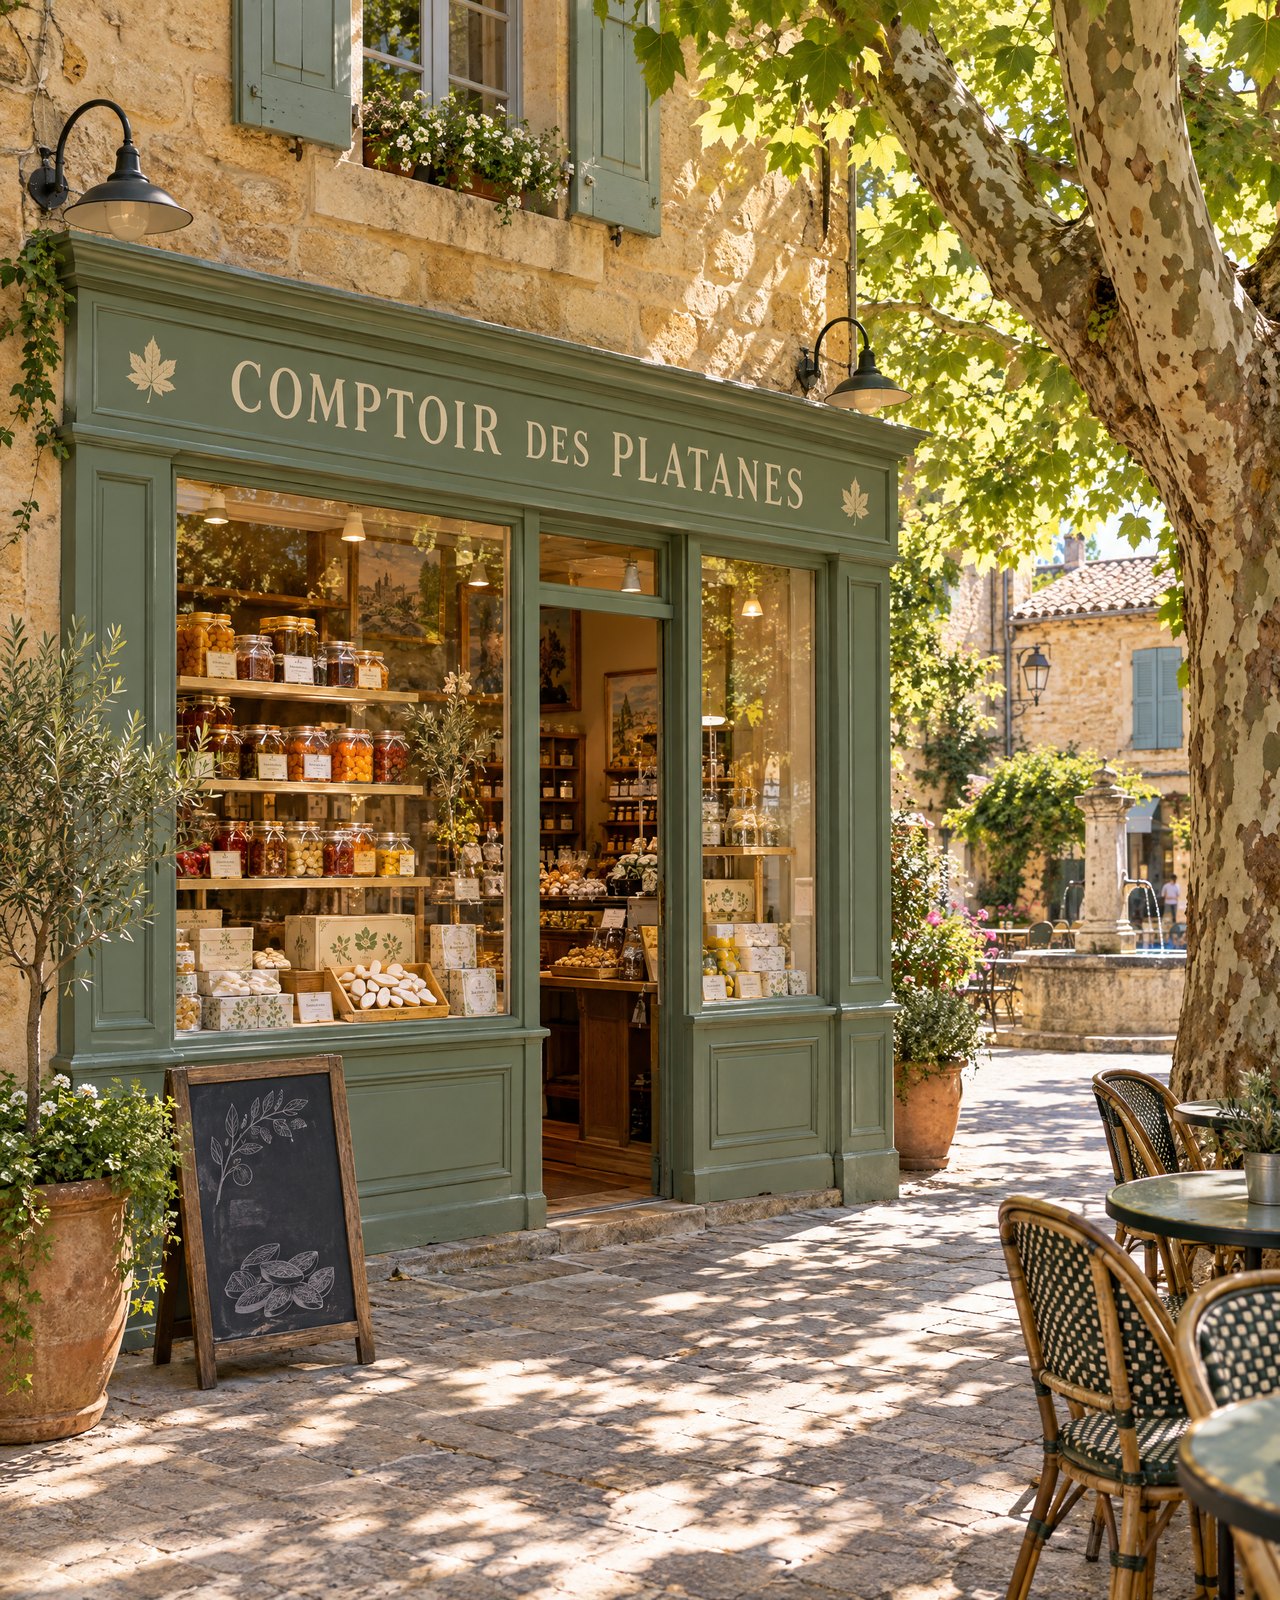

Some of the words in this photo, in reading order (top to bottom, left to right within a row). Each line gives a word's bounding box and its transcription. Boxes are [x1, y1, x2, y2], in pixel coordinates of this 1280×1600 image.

[231, 360, 502, 456] COMPTOIR
[526, 420, 590, 468] DES
[612, 431, 804, 510] PLATANES
